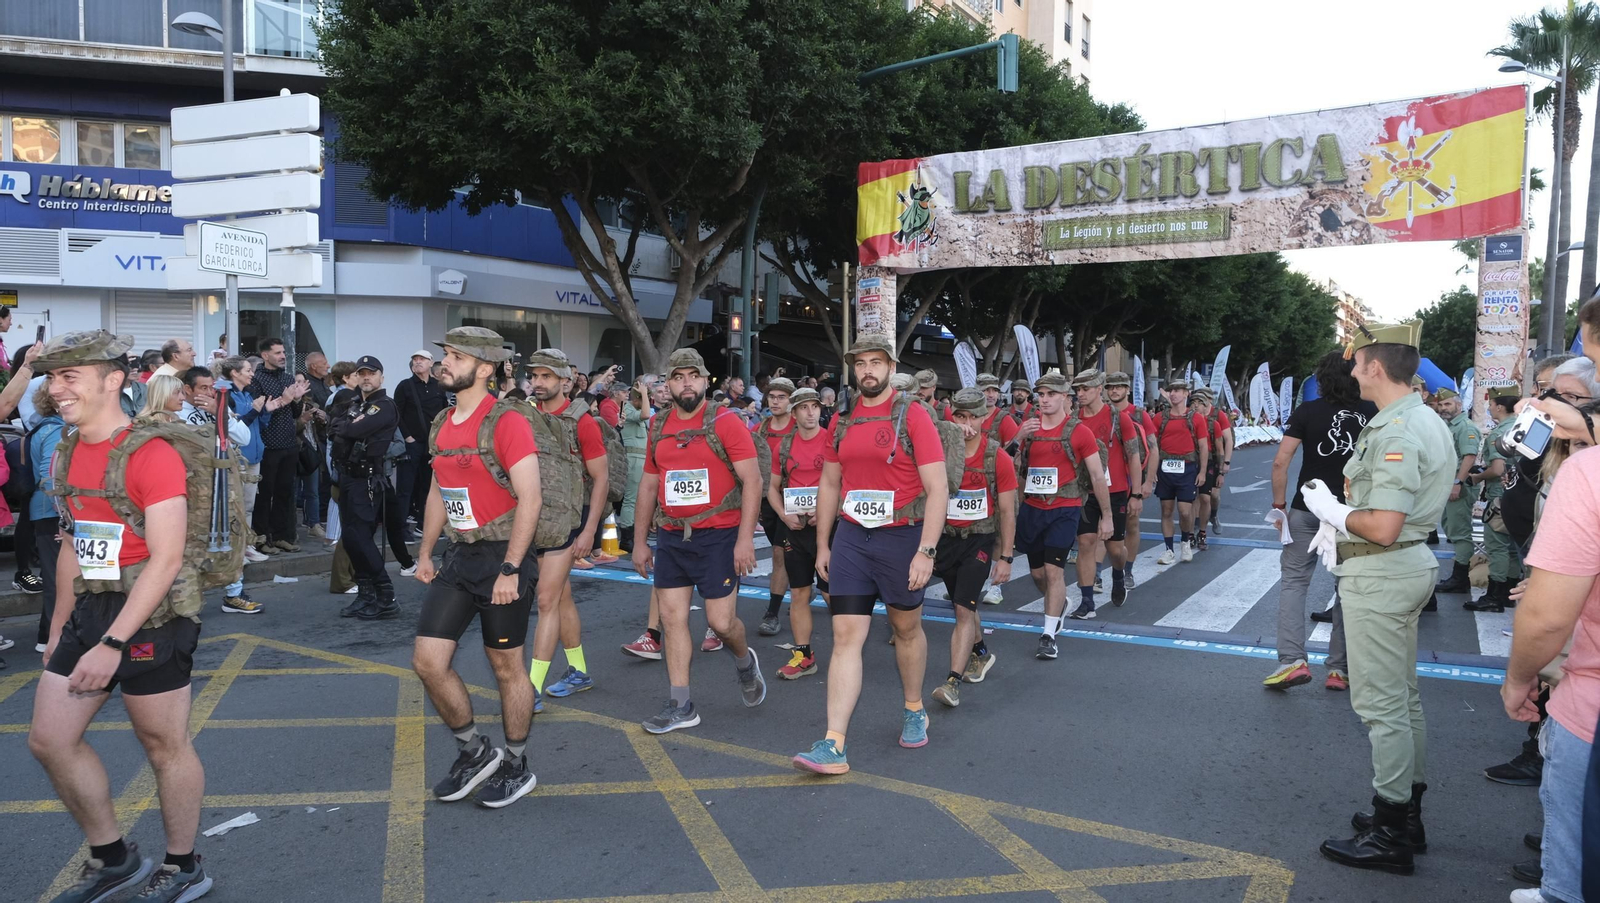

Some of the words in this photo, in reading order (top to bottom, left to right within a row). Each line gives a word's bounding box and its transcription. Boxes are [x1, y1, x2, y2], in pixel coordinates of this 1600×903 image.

[953, 169, 1012, 213] LA
[1024, 133, 1348, 210] DESÉRTICA
[37, 174, 172, 202] Háblame
[38, 199, 79, 210] Centro
[1060, 227, 1070, 239] La
[1073, 224, 1102, 239] Legión
[1106, 226, 1113, 239] y
[1116, 223, 1125, 235] el
[1129, 221, 1165, 234] desierto
[1170, 220, 1187, 231] nos
[1191, 219, 1208, 230] une
[221, 232, 264, 245] AVENIDA
[215, 243, 254, 258] FEDERICO
[205, 253, 236, 268] GARCÍA
[238, 259, 263, 272] LORCA
[1484, 296, 1518, 304] RENTA
[1479, 379, 1517, 387] primaflor
[673, 480, 703, 494] 4952
[1032, 475, 1053, 485] 4975
[854, 501, 886, 516] 4954
[957, 498, 983, 510] 4987
